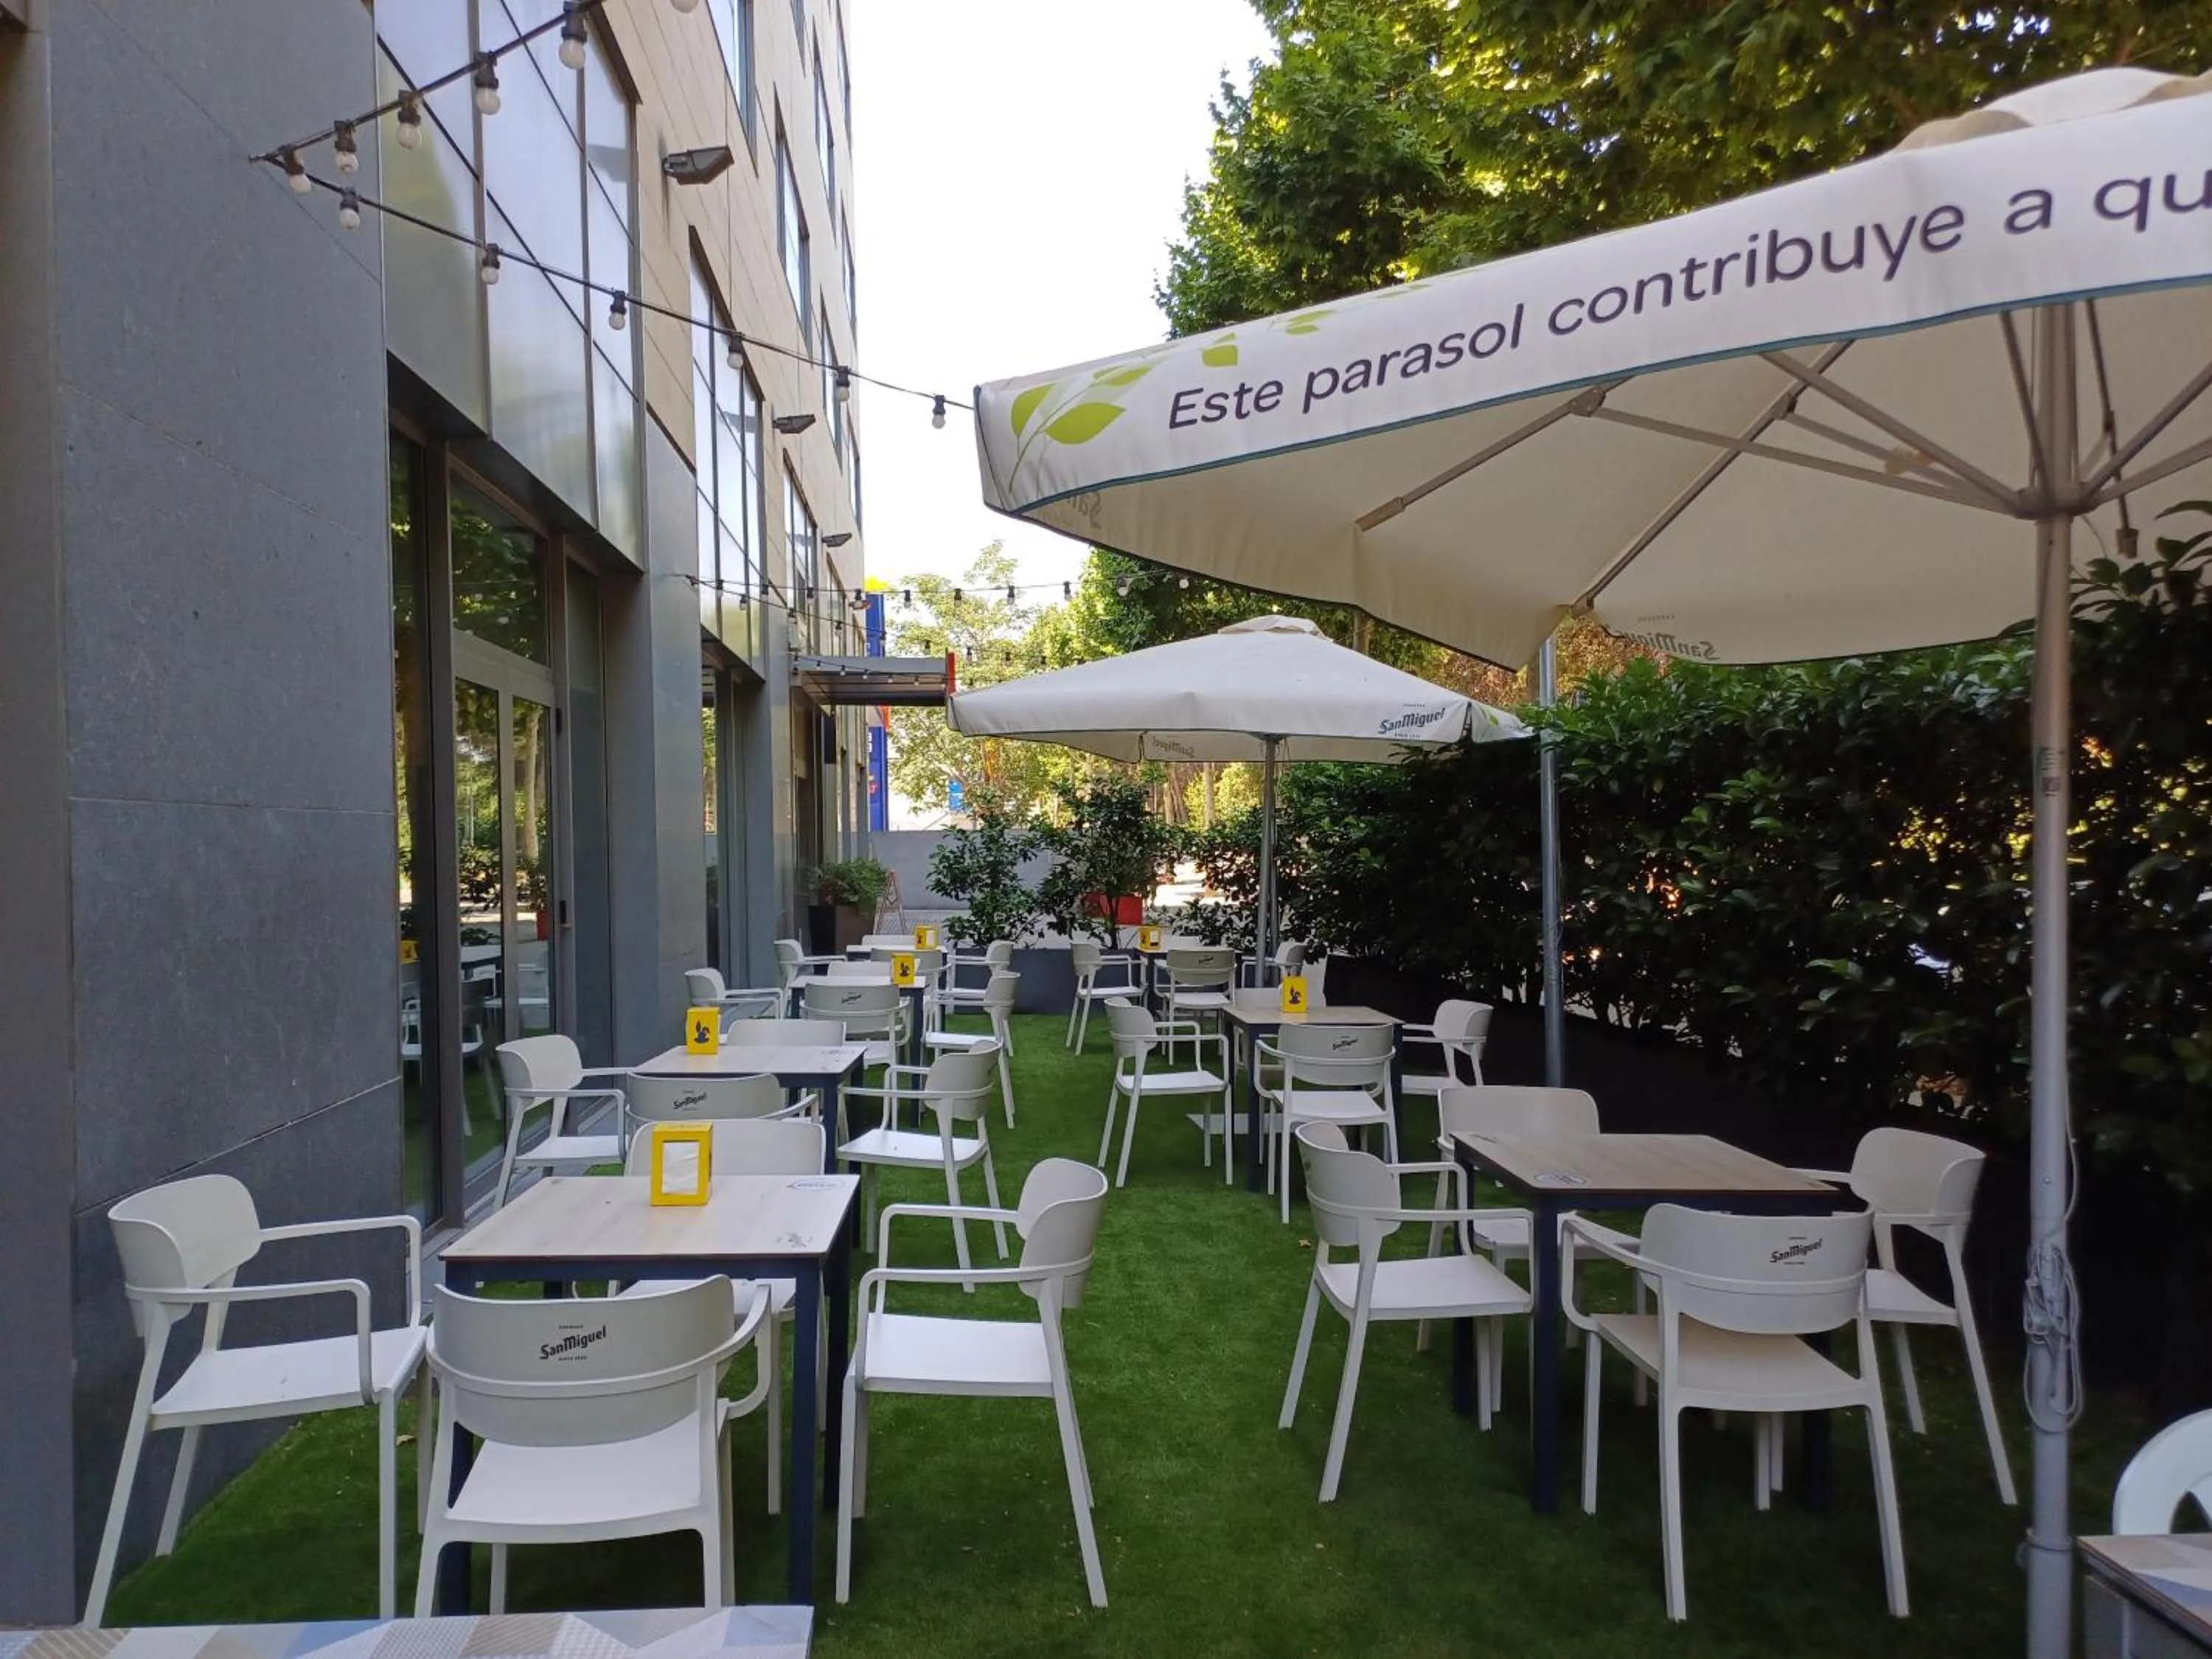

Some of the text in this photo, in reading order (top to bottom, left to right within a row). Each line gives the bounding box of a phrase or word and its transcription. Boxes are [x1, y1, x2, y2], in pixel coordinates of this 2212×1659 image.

[1169, 170, 2212, 430] Este parasol contribuye a qu
[539, 1324, 606, 1360] SanMiguel
